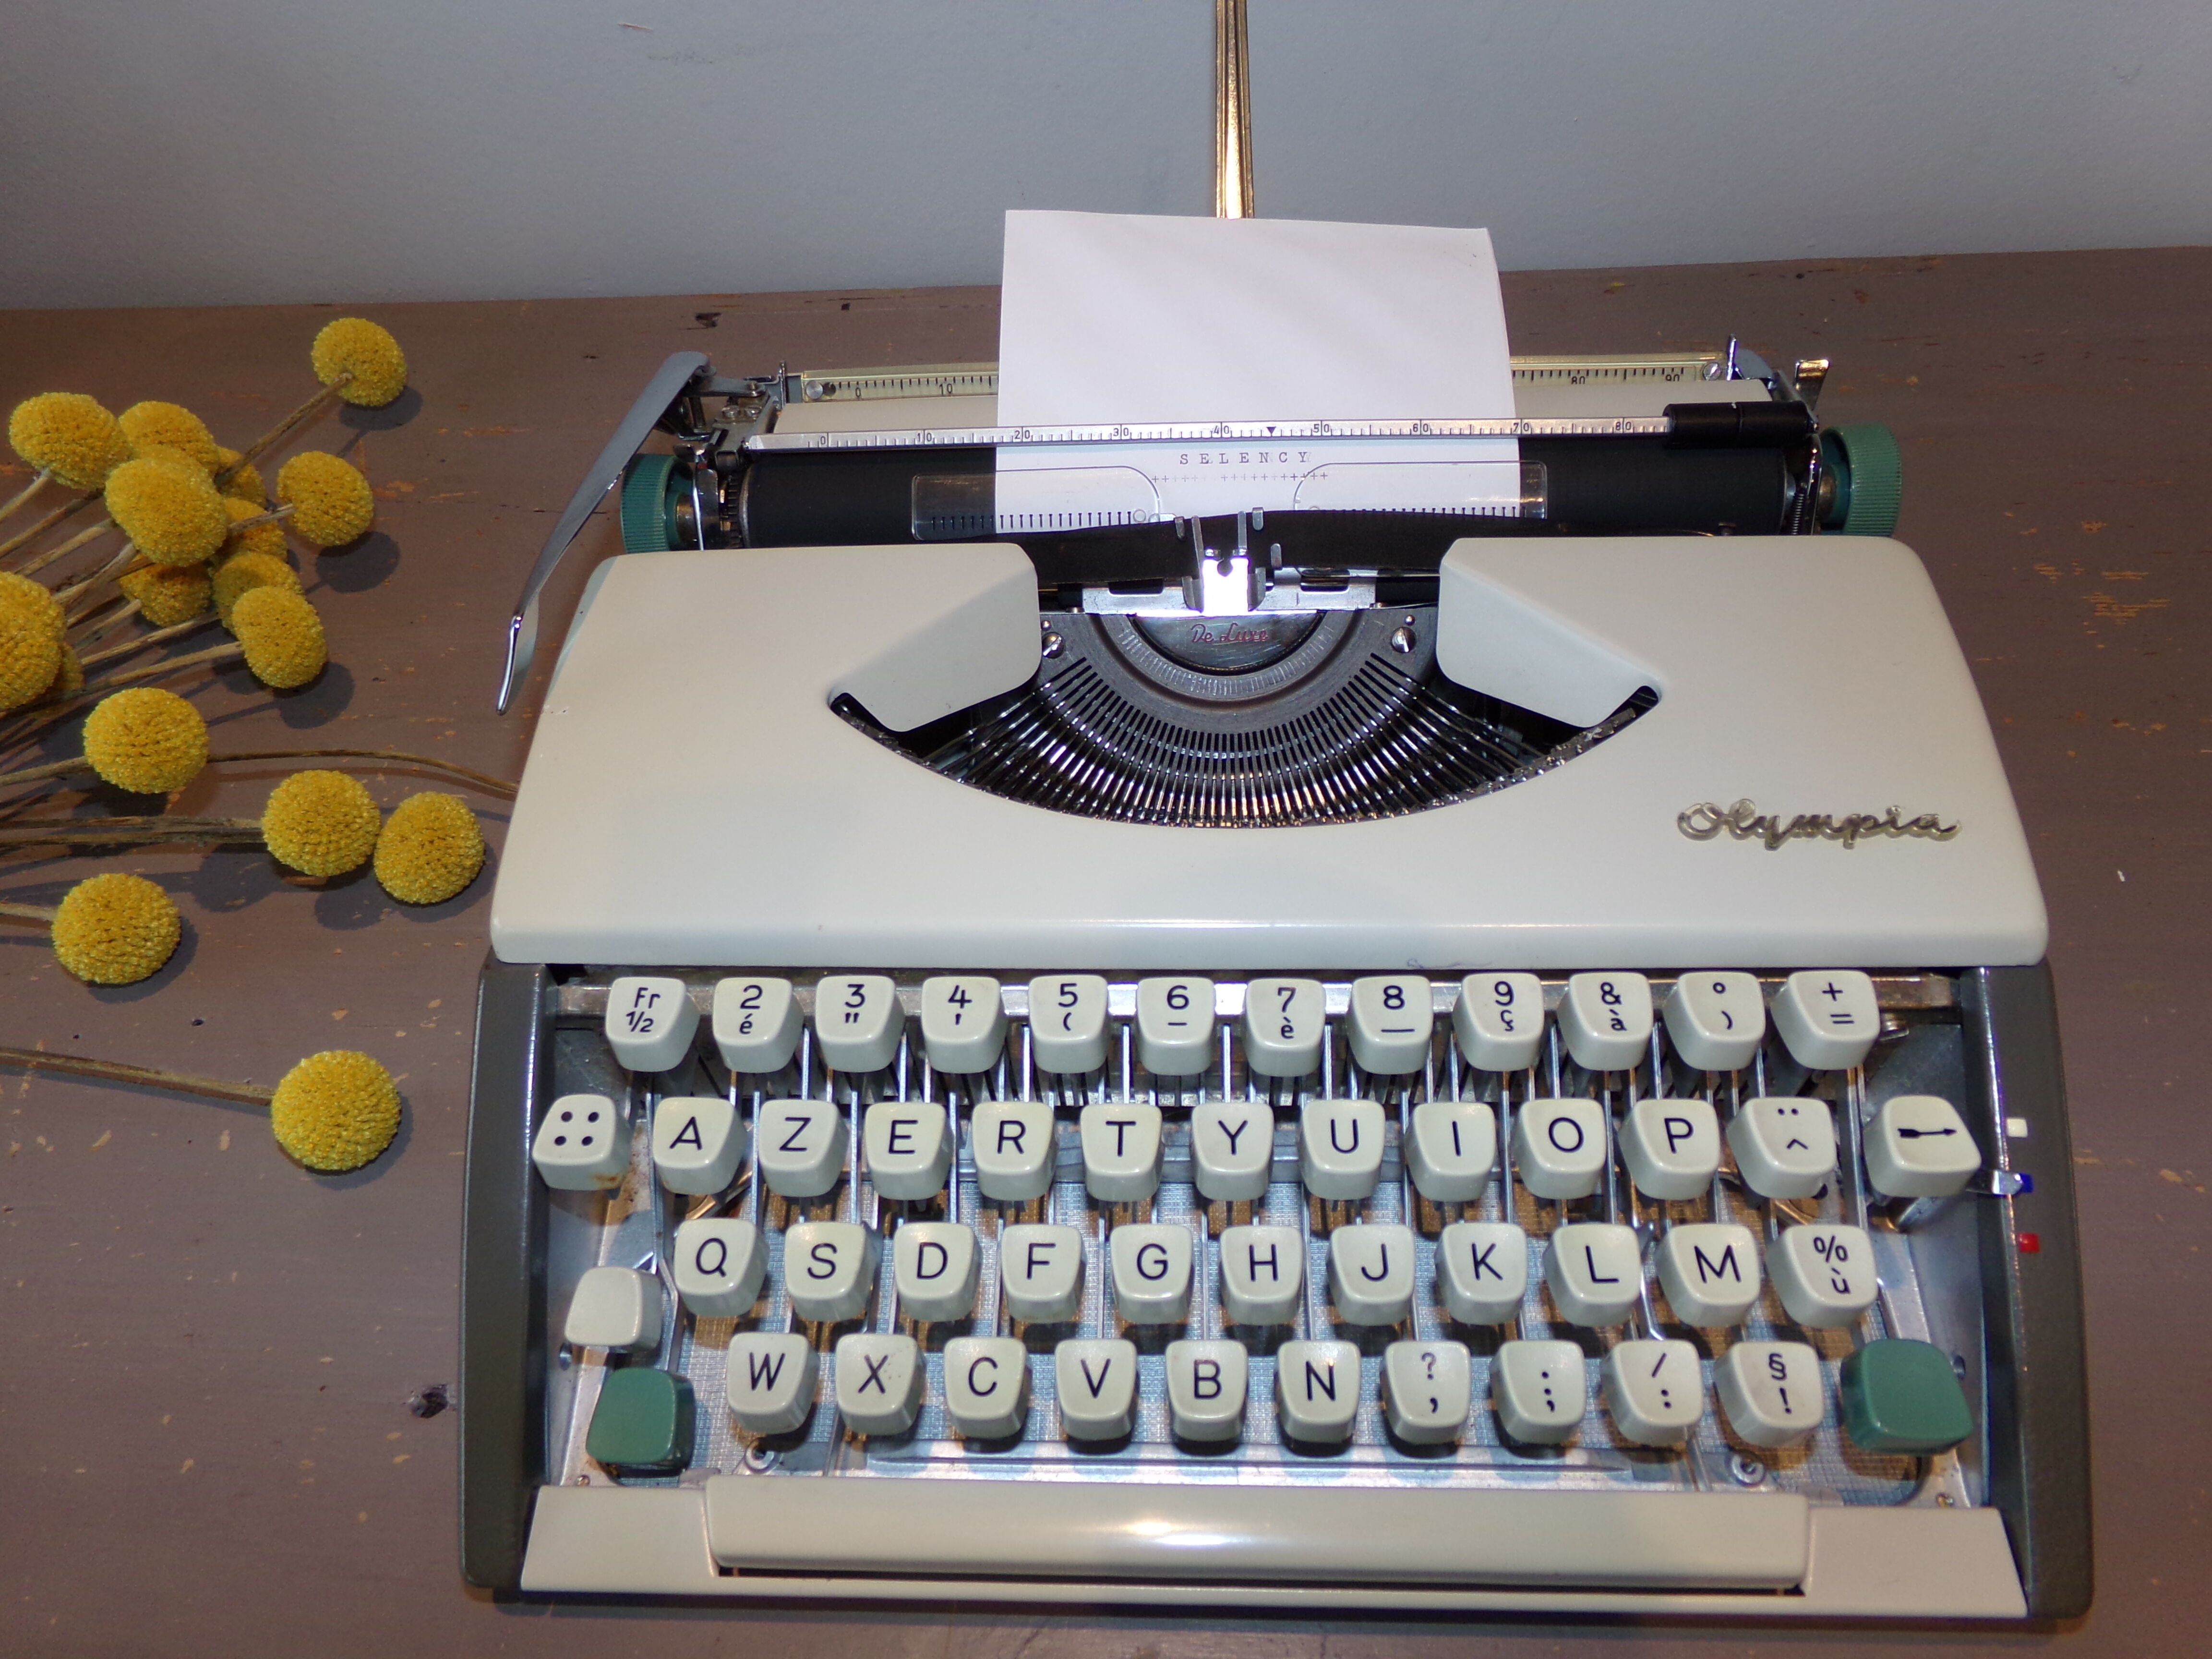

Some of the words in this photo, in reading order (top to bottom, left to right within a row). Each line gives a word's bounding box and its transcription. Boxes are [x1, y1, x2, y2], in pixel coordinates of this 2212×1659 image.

[854, 386, 861, 398] 0
[939, 384, 953, 395] 10
[820, 435, 827, 446] 0
[917, 432, 933, 443] 10
[1014, 429, 1031, 440] 20
[1113, 427, 1130, 438] 30
[1213, 424, 1230, 435] 40
[1313, 423, 1330, 434] 50
[1413, 423, 1429, 434] 60
[1513, 422, 1529, 433] 70
[1615, 421, 1632, 431] 80
[1179, 452, 1310, 465] SELENCY
[1190, 623, 1214, 643] De
[1219, 621, 1269, 642] Luxe
[1677, 798, 1963, 851] Olympia
[634, 987, 661, 1009] Fr
[740, 985, 763, 1010] 2
[845, 984, 866, 1009] 3
[948, 985, 973, 1009] 4
[1058, 983, 1078, 1008] 5
[1166, 985, 1190, 1010] 6
[1277, 987, 1296, 1013] 7
[1383, 985, 1405, 1010] 8
[1494, 981, 1514, 1007] 9
[1600, 982, 1622, 1005] &
[626, 1011, 654, 1033] 1/2
[739, 1013, 753, 1034] é
[1281, 1016, 1294, 1039] è
[1609, 1009, 1627, 1031] à
[1830, 1013, 1854, 1024] =
[669, 1116, 702, 1151] A
[779, 1117, 811, 1152] Z
[888, 1119, 918, 1154] E
[997, 1120, 1026, 1154] R
[1106, 1120, 1136, 1157] T
[1218, 1120, 1248, 1155] Y
[1330, 1118, 1359, 1154] U
[1548, 1117, 1584, 1153] O
[1664, 1118, 1694, 1154] P
[696, 1238, 727, 1277] Q
[807, 1243, 837, 1280] S
[916, 1242, 948, 1280] D
[1026, 1243, 1056, 1280] F
[1136, 1243, 1168, 1281] G
[1249, 1244, 1278, 1282] H
[1361, 1243, 1389, 1282] J
[1471, 1243, 1503, 1280] K
[1585, 1245, 1619, 1284] L
[1694, 1245, 1741, 1284] M
[1813, 1235, 1848, 1263] %
[1831, 1268, 1851, 1294] ù
[749, 1352, 785, 1392] W
[858, 1355, 888, 1395] X
[968, 1357, 998, 1397] C
[1081, 1358, 1110, 1399] V
[1193, 1360, 1222, 1400] B
[1305, 1360, 1336, 1402] N
[1421, 1352, 1435, 1380] ?
[1768, 1353, 1787, 1381] §
[1779, 1387, 1791, 1414] !
